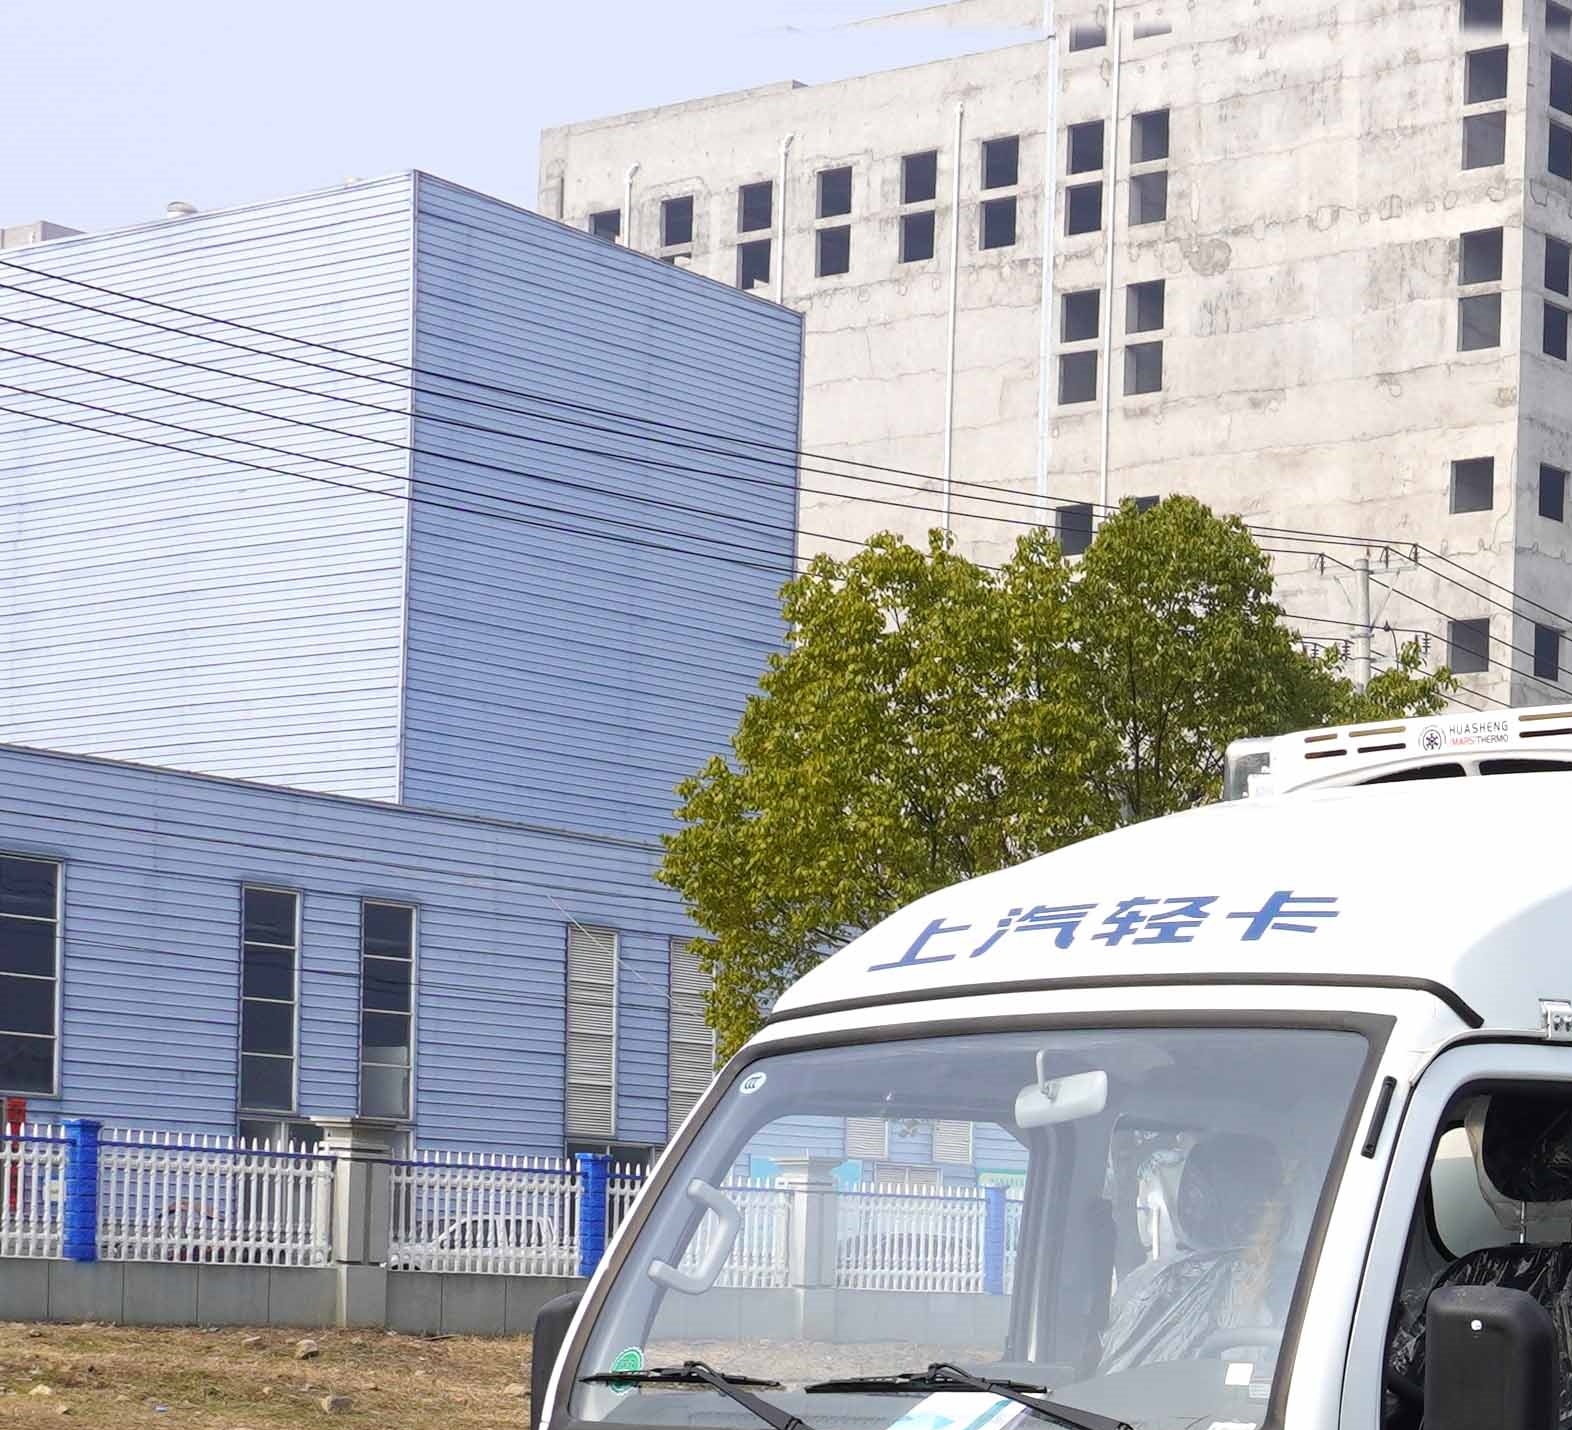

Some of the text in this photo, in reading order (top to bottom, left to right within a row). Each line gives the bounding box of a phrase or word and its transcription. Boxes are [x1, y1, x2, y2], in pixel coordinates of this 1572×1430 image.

[1449, 720, 1509, 736] HUASHENG
[866, 889, 1340, 973] 上汽轻卡
